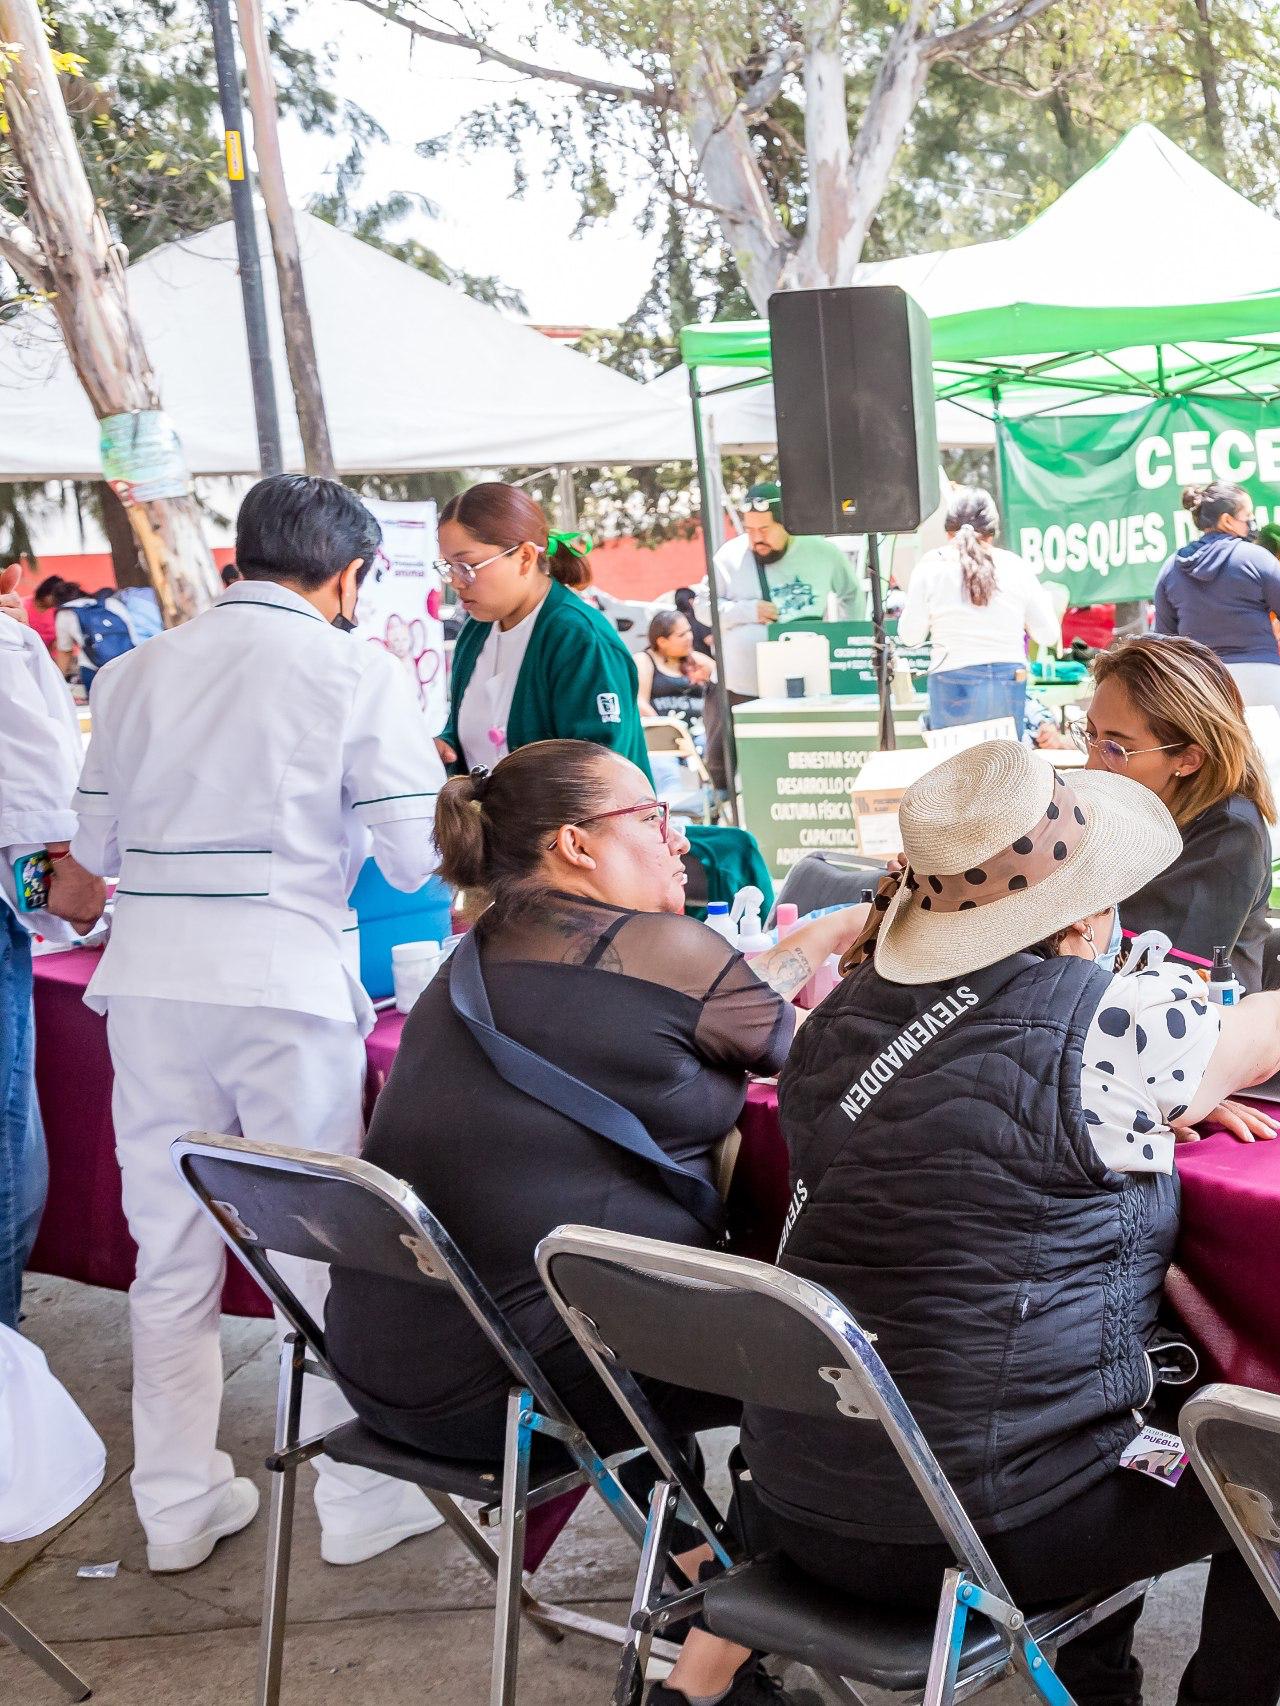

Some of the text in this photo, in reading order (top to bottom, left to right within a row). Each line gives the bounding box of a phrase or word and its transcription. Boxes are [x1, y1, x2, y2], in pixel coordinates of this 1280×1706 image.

[1019, 511, 1168, 577] BOSQUES
[839, 984, 980, 1122] STEVEMADDEN
[1143, 1434, 1180, 1449] PUEBLA
